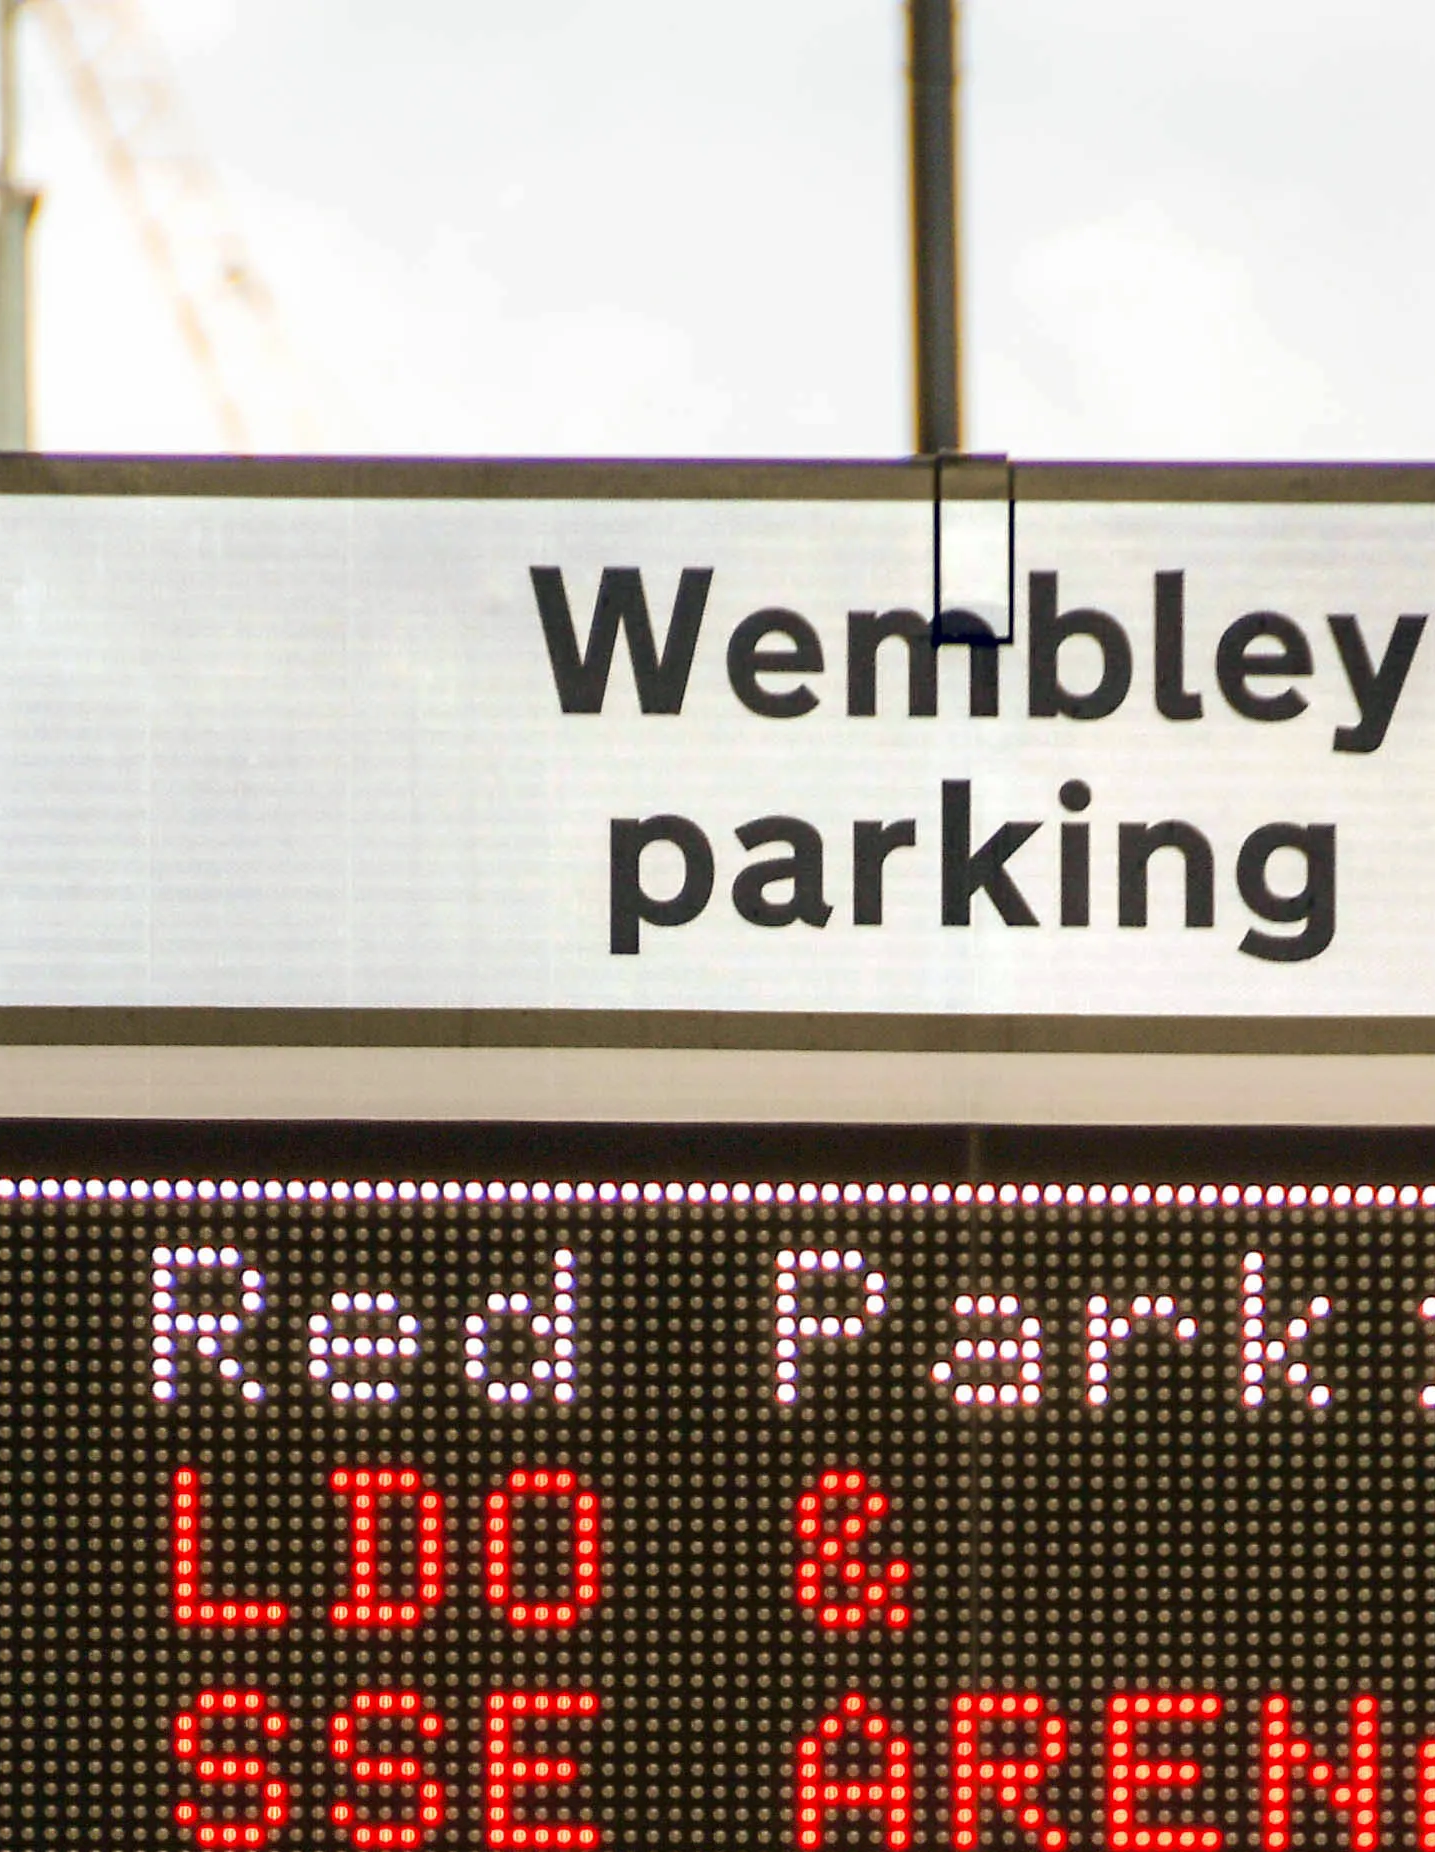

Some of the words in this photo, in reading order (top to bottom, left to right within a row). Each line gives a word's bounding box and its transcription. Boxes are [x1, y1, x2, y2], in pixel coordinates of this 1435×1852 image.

[530, 566, 1428, 754] Wembley
[608, 780, 1337, 963] parking
[150, 1244, 576, 1406] Red
[170, 1465, 602, 1630] LDO
[794, 1468, 913, 1631] &
[171, 1687, 602, 1852] SSE
